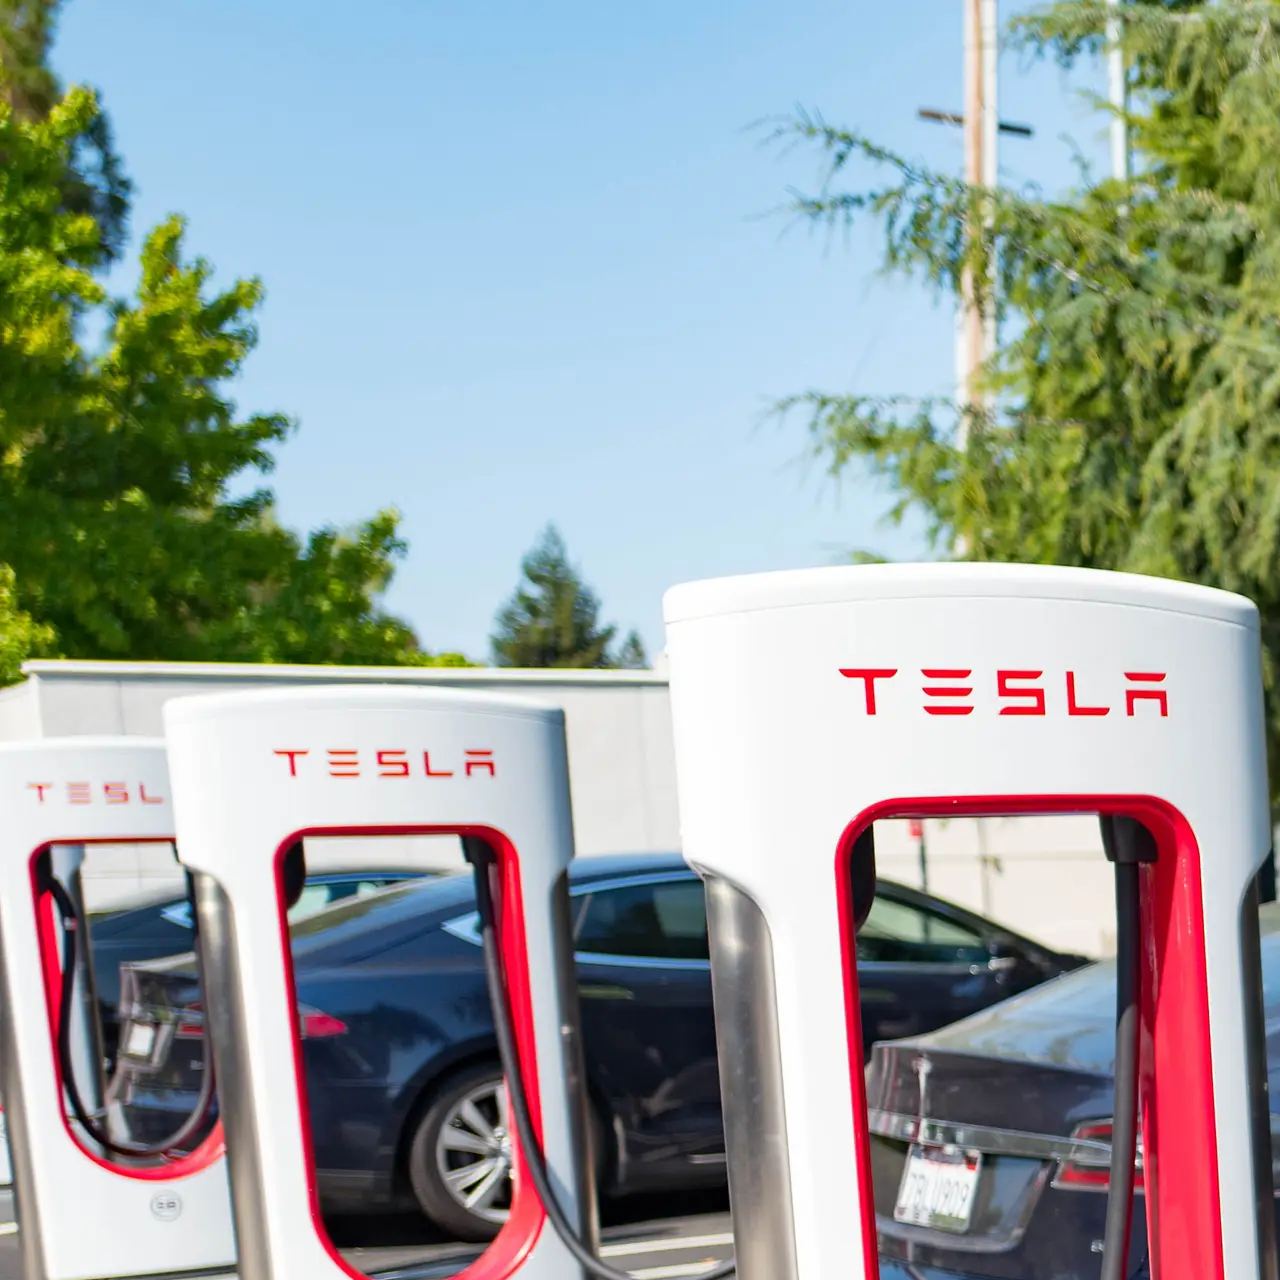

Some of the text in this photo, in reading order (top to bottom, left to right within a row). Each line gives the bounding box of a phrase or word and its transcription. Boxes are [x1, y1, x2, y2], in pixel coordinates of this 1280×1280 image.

[838, 668, 1168, 717] TESLA
[273, 749, 497, 778] TESLA
[26, 781, 164, 805] TESL
